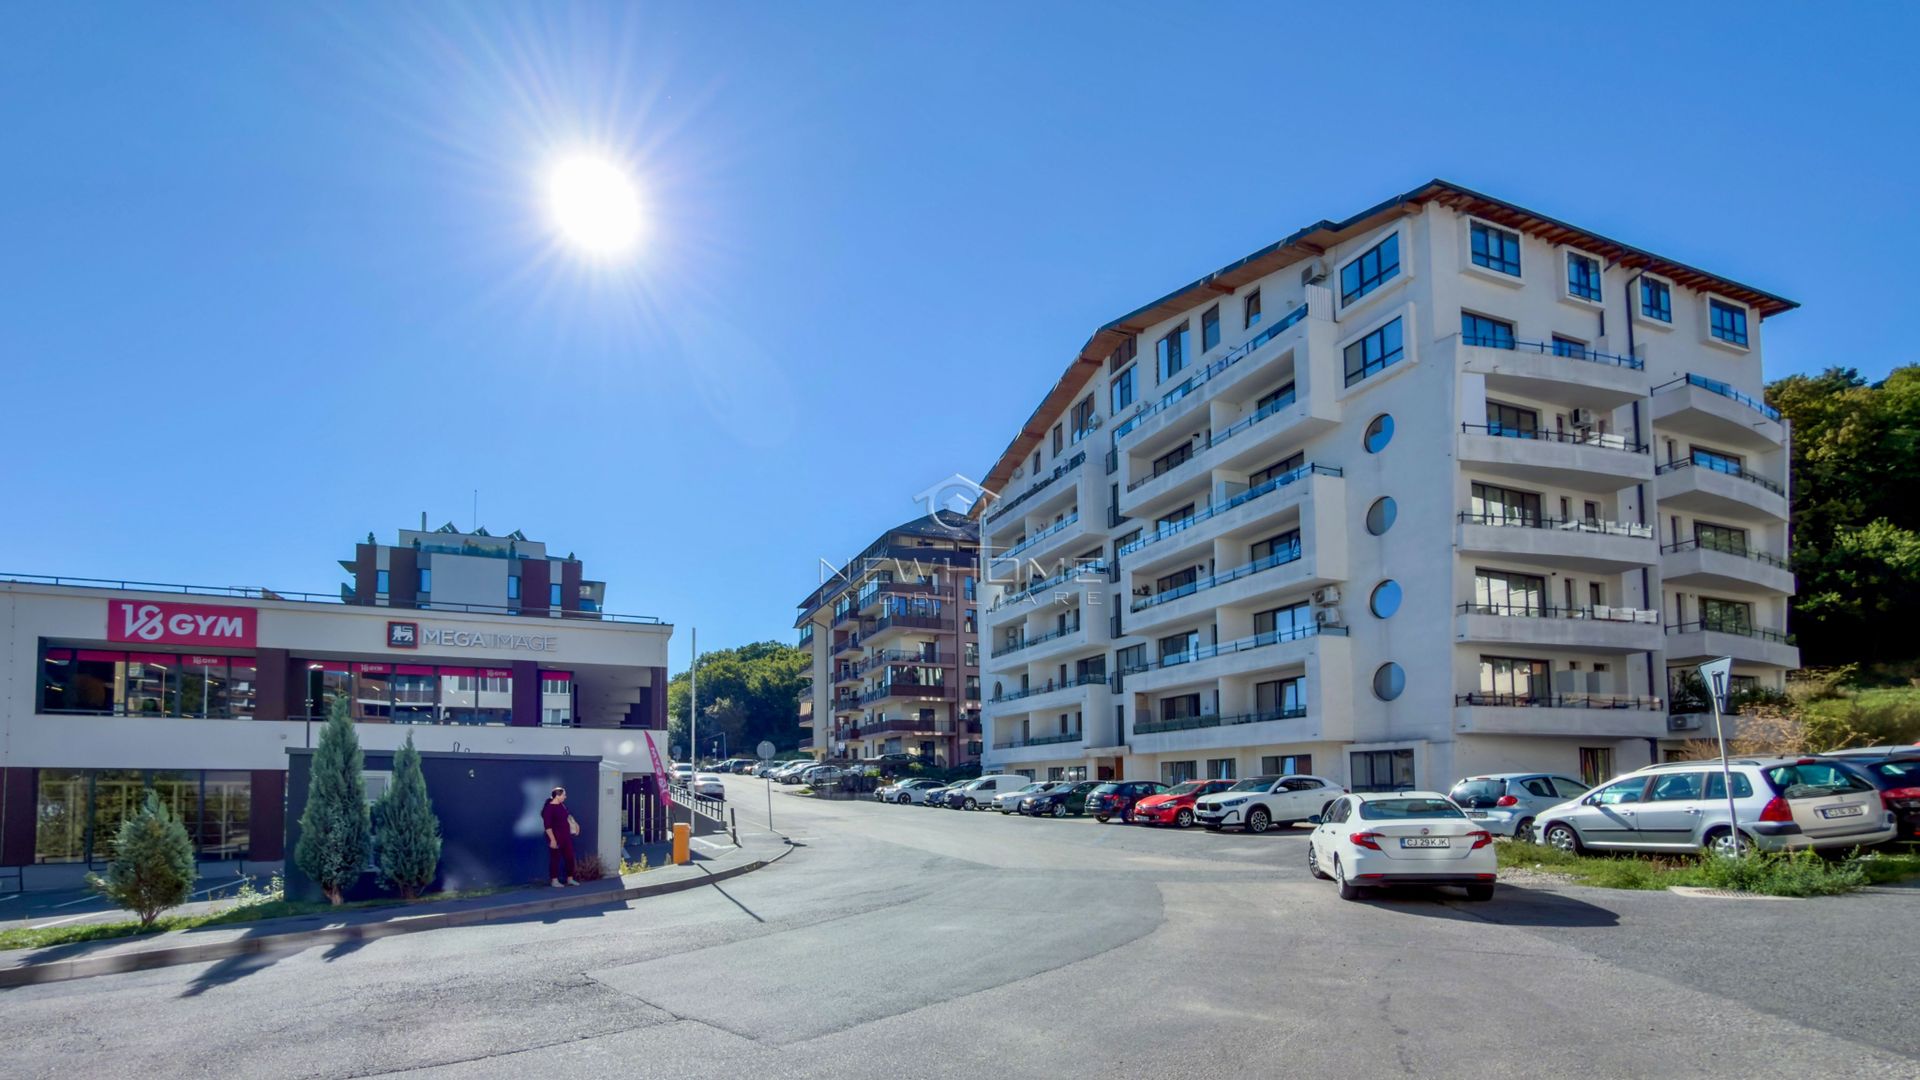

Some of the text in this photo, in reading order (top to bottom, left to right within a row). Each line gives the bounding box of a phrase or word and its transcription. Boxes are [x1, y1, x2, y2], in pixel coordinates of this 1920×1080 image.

[169, 613, 243, 638] GYM
[422, 628, 558, 652] MEGA IMAGE
